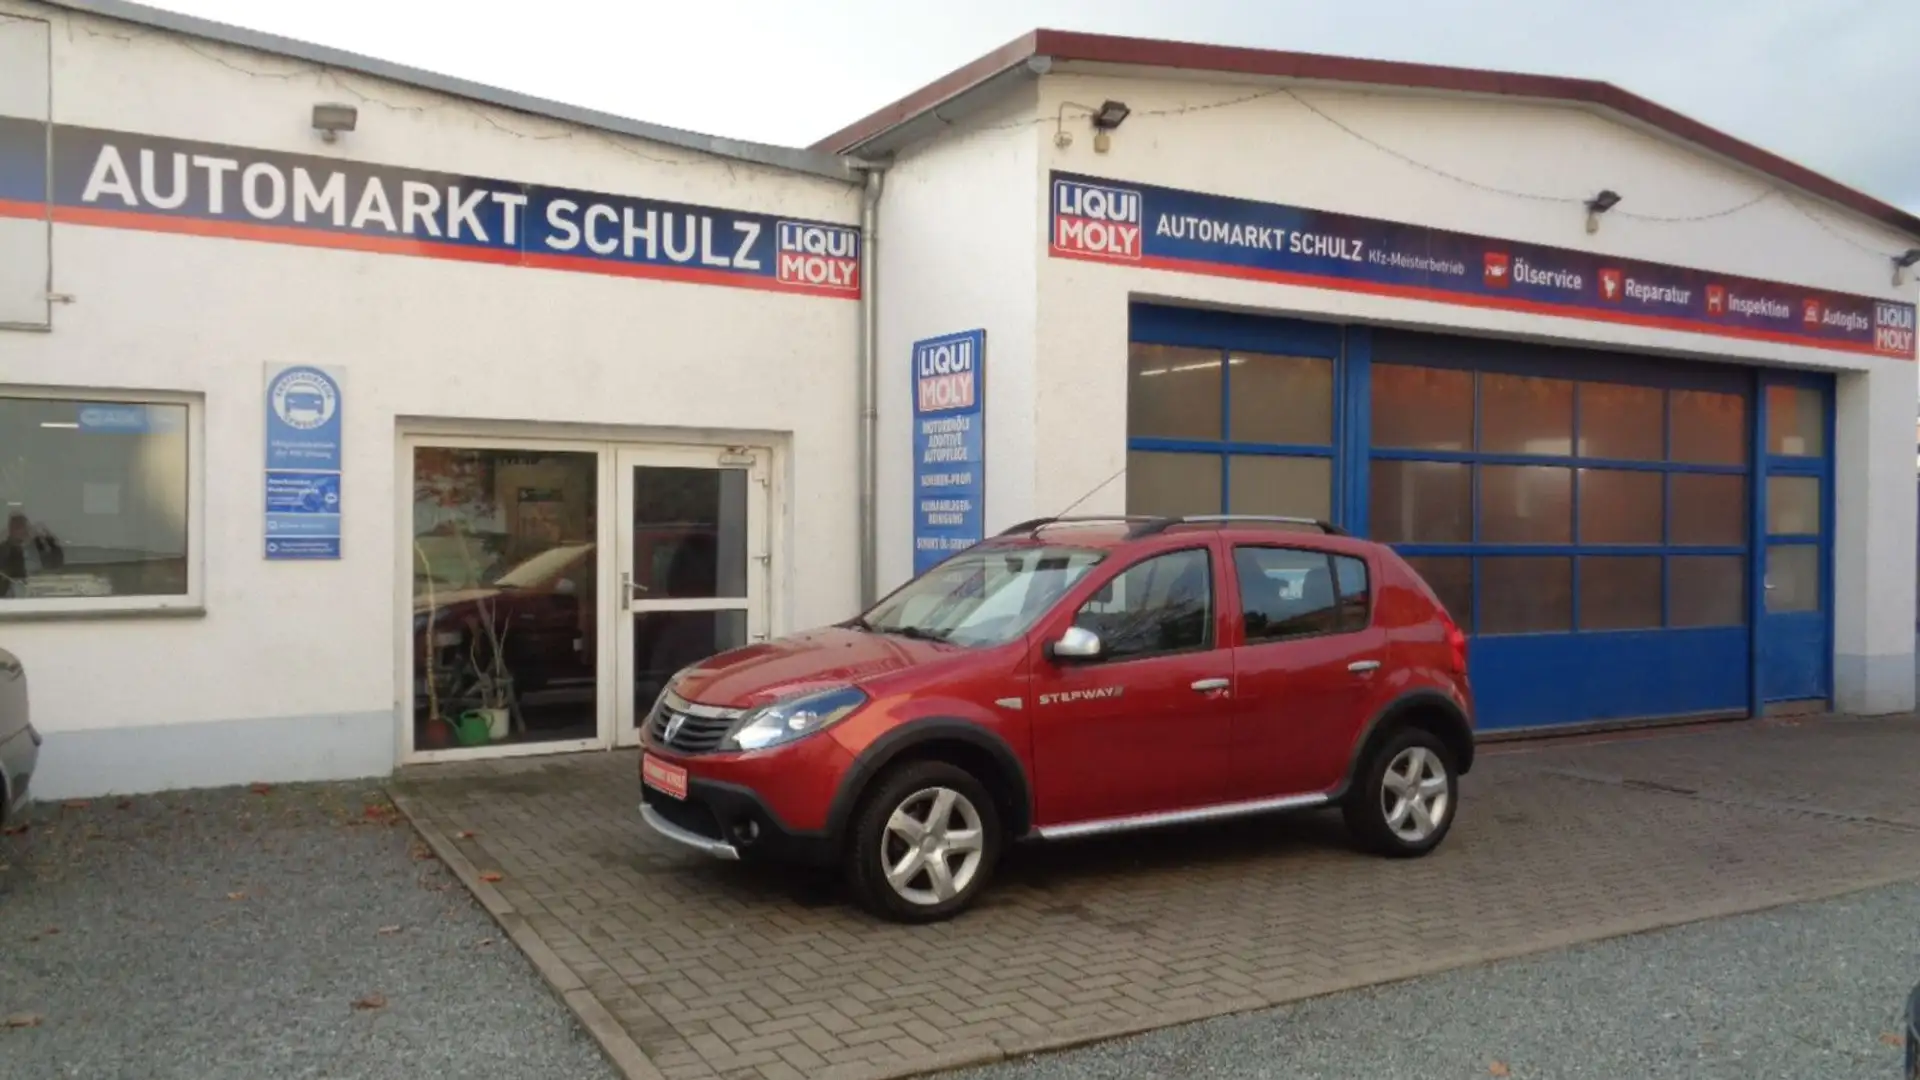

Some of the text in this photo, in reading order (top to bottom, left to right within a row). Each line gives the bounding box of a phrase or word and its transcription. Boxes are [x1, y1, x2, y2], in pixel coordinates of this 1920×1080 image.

[82, 144, 761, 270] AUTOMARKT SCHULZ
[1060, 184, 1137, 222] LIQUI
[781, 225, 855, 258] LIQUI
[1060, 216, 1138, 255] MOLY
[1156, 213, 1466, 277] AUTOMARKT SCHULZ Kfz-Meisterbetrieb
[781, 255, 857, 286] MOLY
[1513, 257, 1583, 290] Ölservice
[1625, 278, 1691, 306] Reparatur
[1728, 293, 1790, 319] Inspektion
[1822, 309, 1869, 332] Autoglas
[1876, 305, 1911, 330] LIQUI
[1876, 326, 1912, 351] MOLY
[920, 341, 971, 377] LIQUI
[920, 377, 974, 408] MOLY
[1039, 687, 1114, 705] STEPWAY
